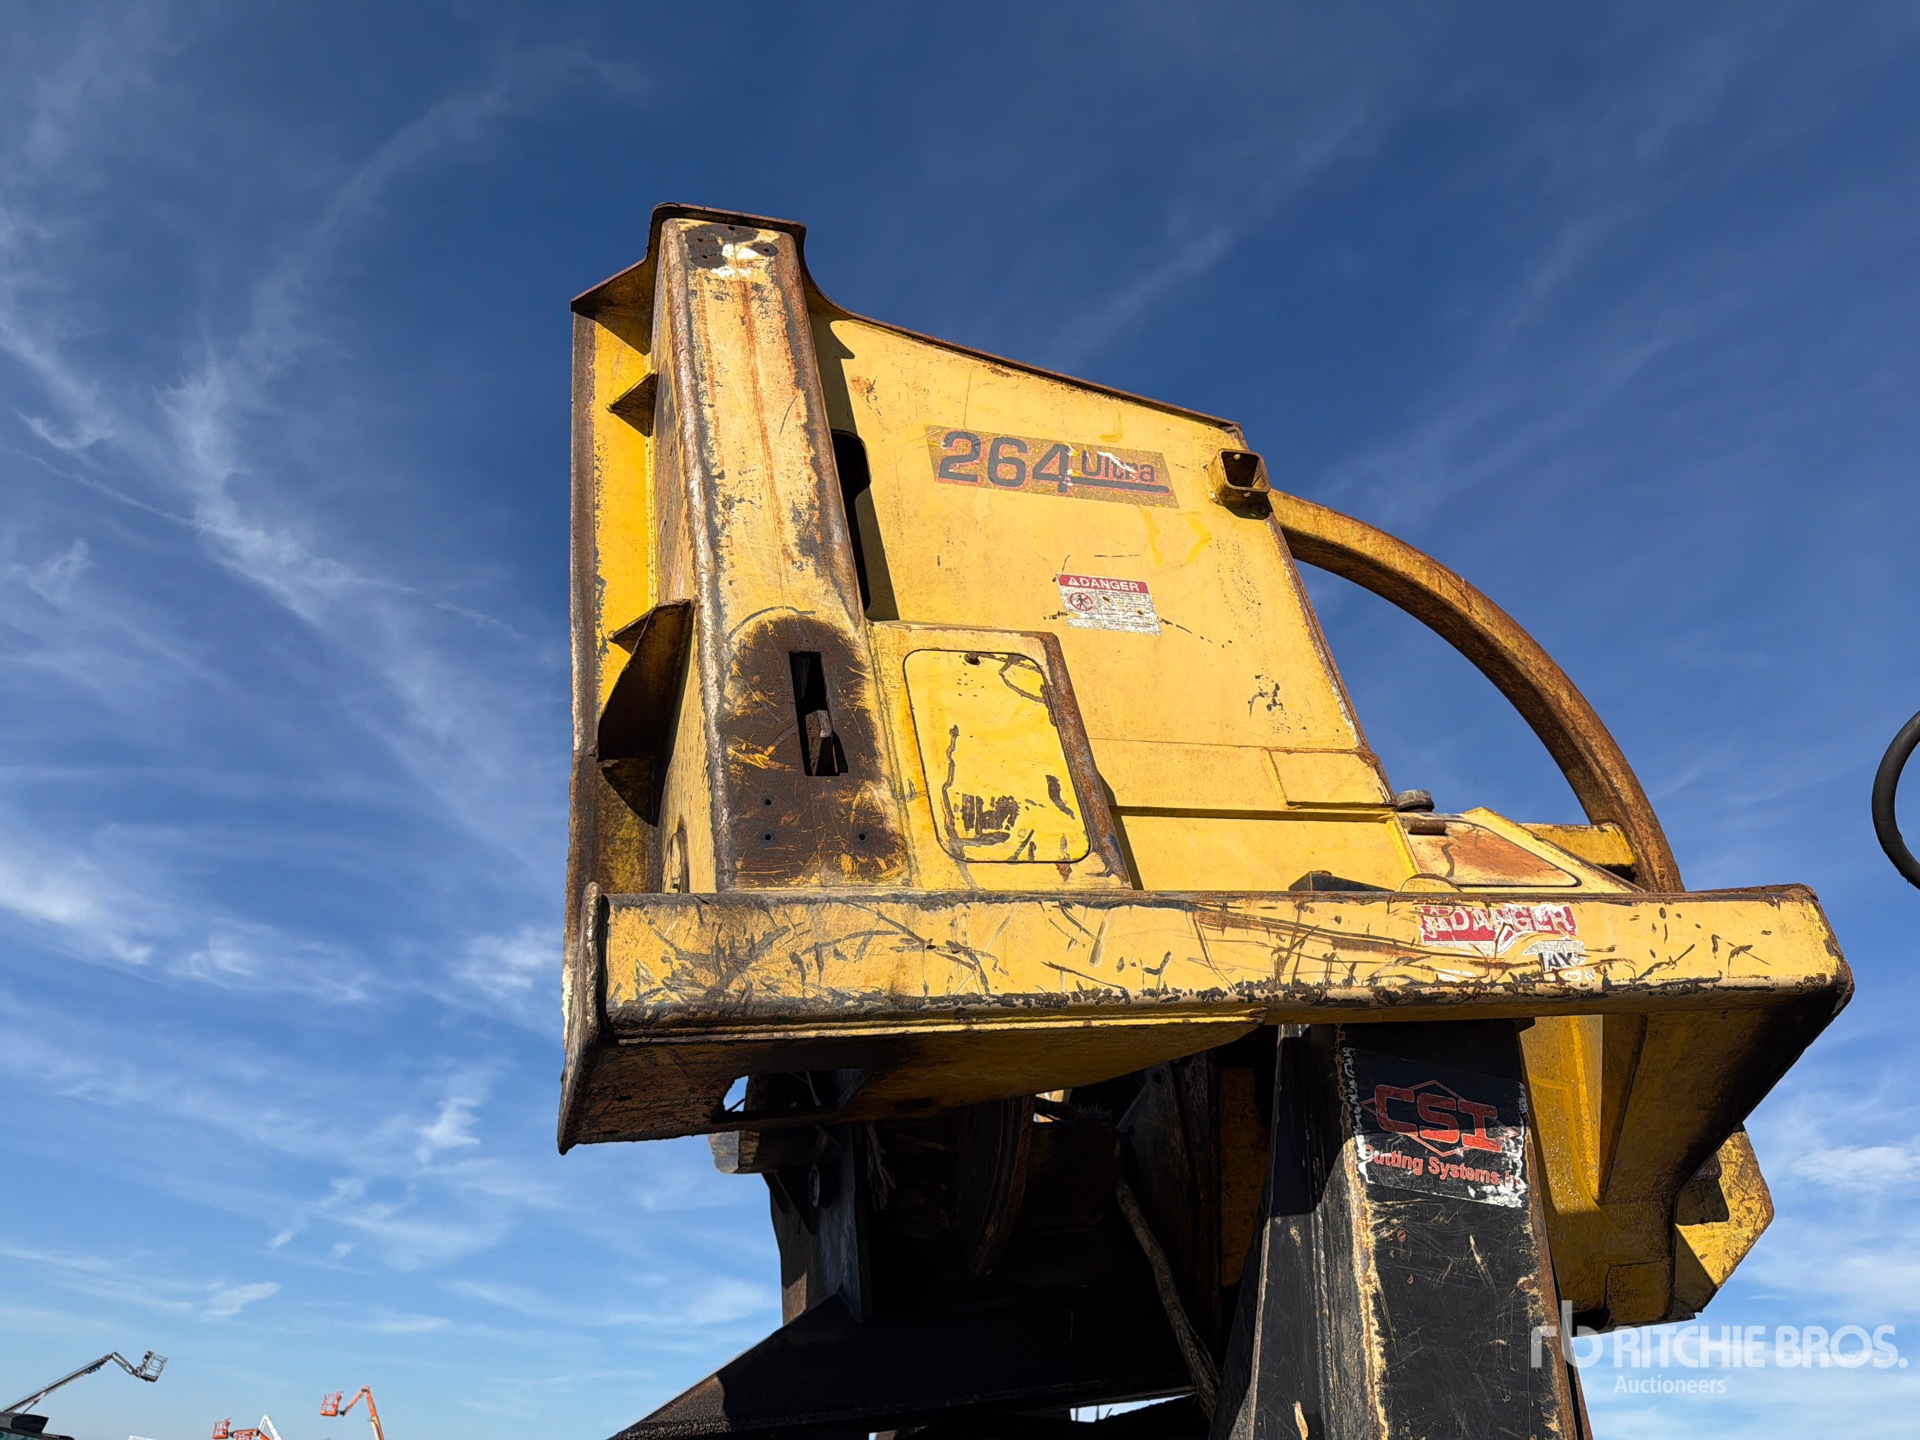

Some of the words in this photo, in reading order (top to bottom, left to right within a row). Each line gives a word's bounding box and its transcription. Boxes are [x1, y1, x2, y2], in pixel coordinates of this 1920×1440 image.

[938, 430, 1072, 494] 264
[1081, 449, 1156, 483] Ultra
[1079, 577, 1140, 592] DANGER
[1451, 905, 1572, 933] DANGER
[1374, 1085, 1502, 1153] CSI
[1428, 1156, 1501, 1186] Systems
